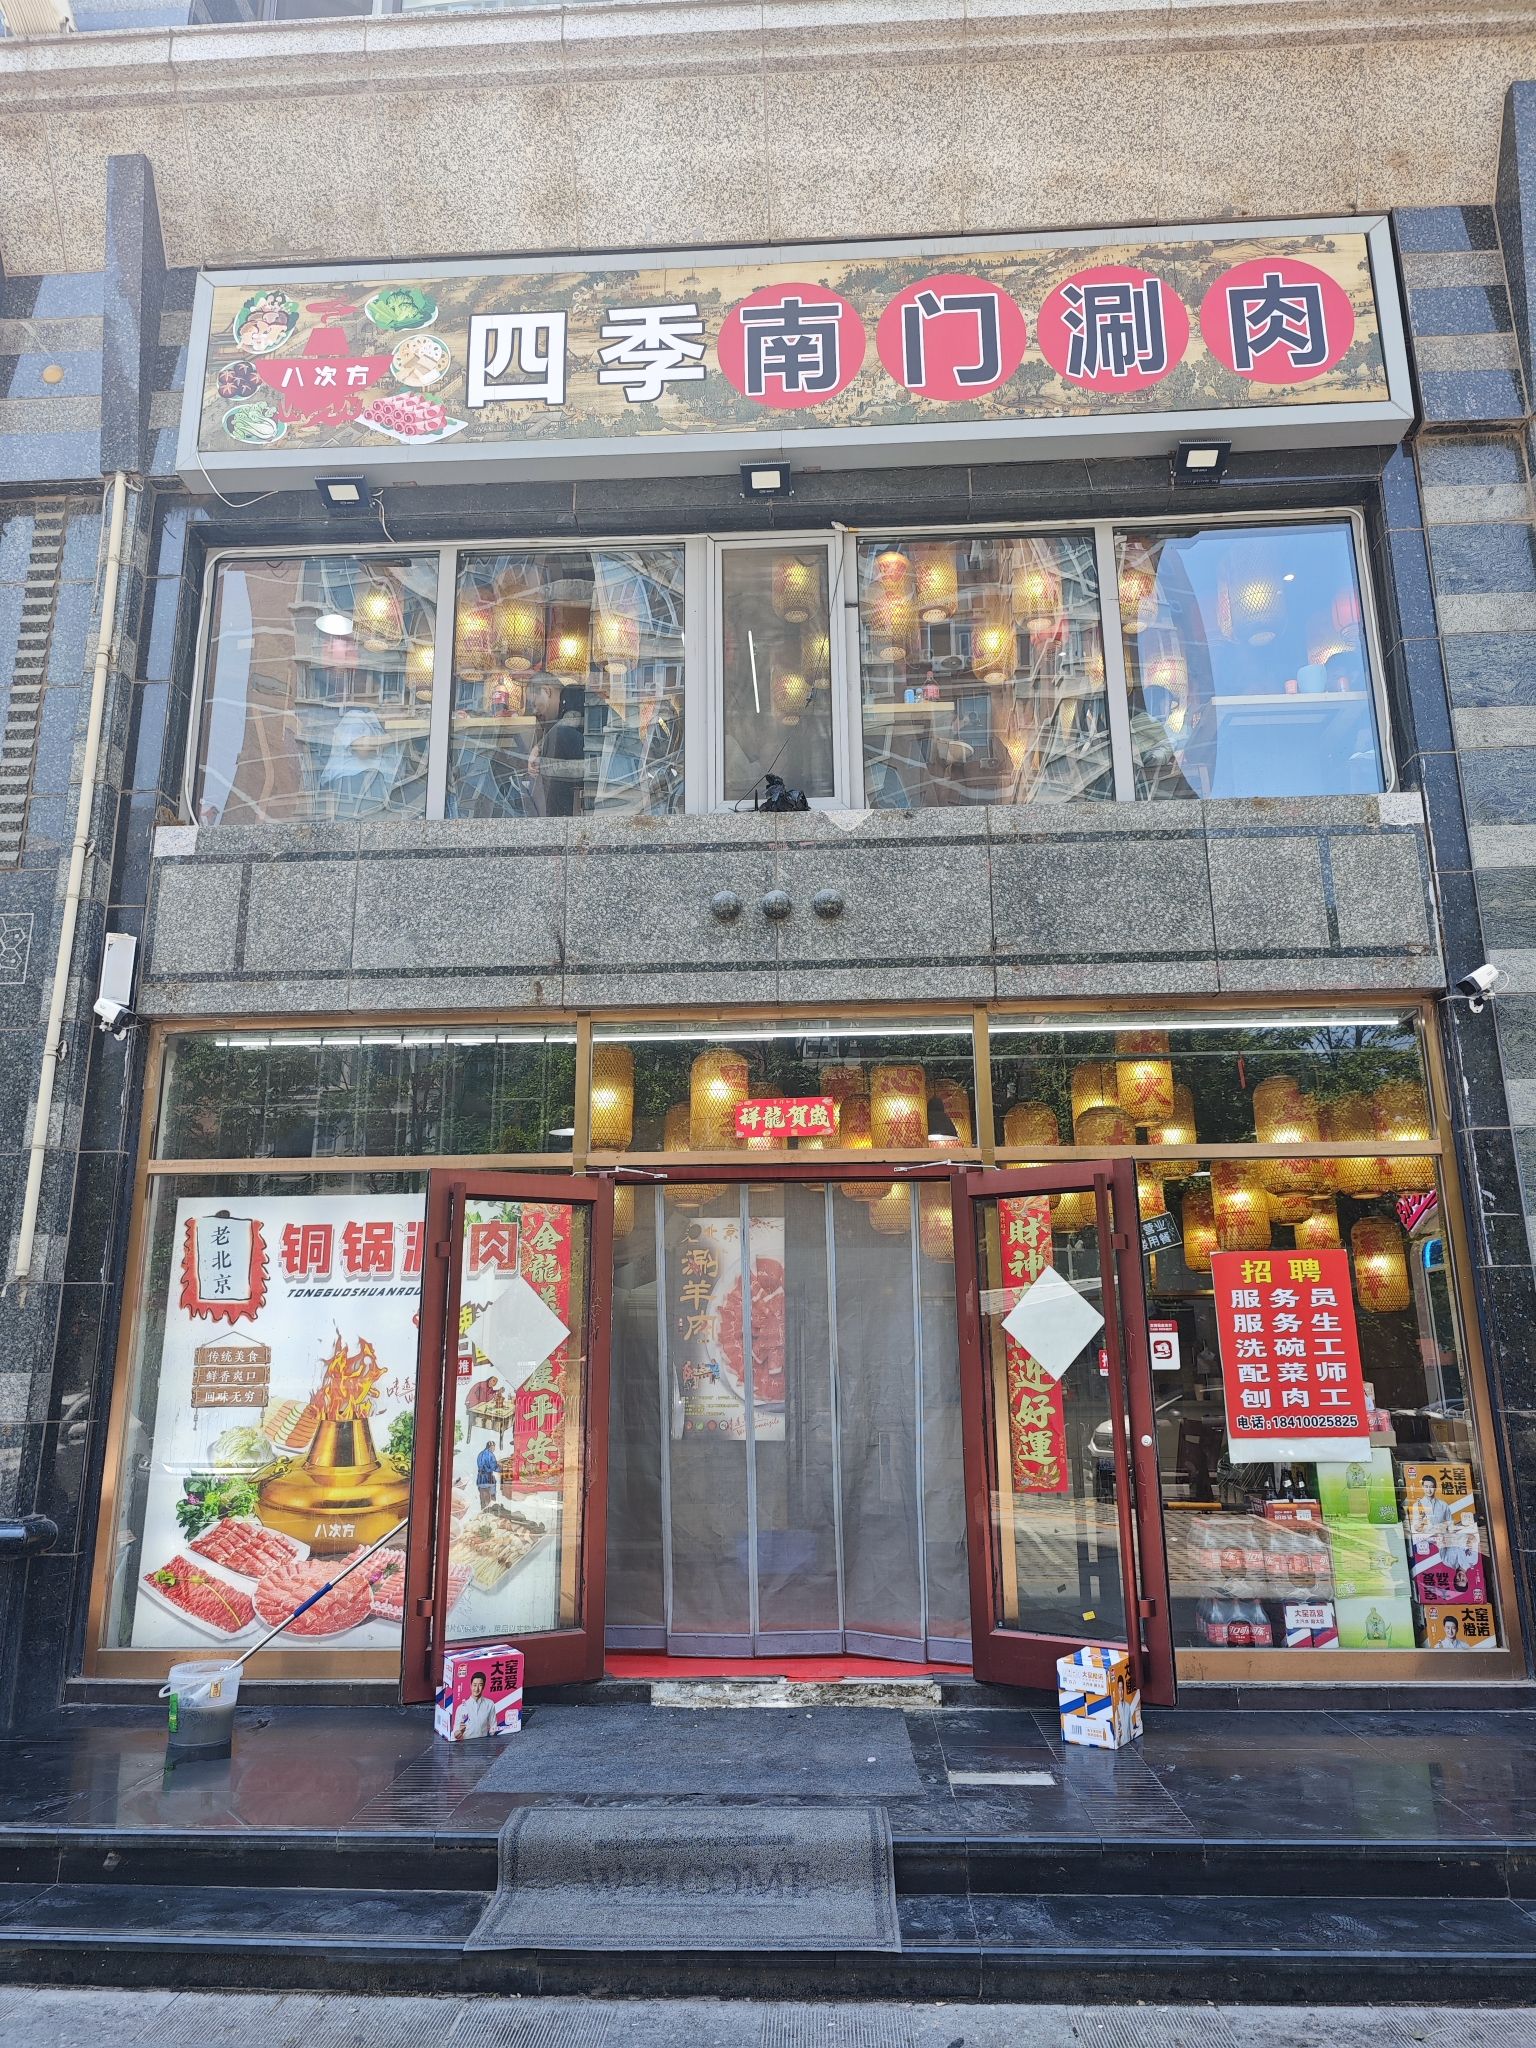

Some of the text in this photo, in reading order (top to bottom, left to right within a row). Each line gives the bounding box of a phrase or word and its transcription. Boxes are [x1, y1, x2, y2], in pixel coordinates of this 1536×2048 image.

[467, 272, 1329, 409] 四季南门涮肉
[281, 364, 370, 388] 八次方
[1143, 1219, 1167, 1236] 营业
[210, 1225, 232, 1295] 老北京
[1240, 1257, 1322, 1284] 招聘
[1230, 1287, 1339, 1309] 服务员
[1233, 1312, 1342, 1333] 服务生
[207, 1350, 259, 1363] 传统美食
[1235, 1337, 1345, 1358] 洗碗工
[205, 1370, 257, 1383] 鲜香爽口
[1237, 1361, 1347, 1383] 配菜师
[203, 1391, 256, 1403] 回味无穷
[1239, 1387, 1351, 1409] 刨肉工
[314, 1523, 356, 1538] 八次方
[1461, 1607, 1489, 1622] 大窑
